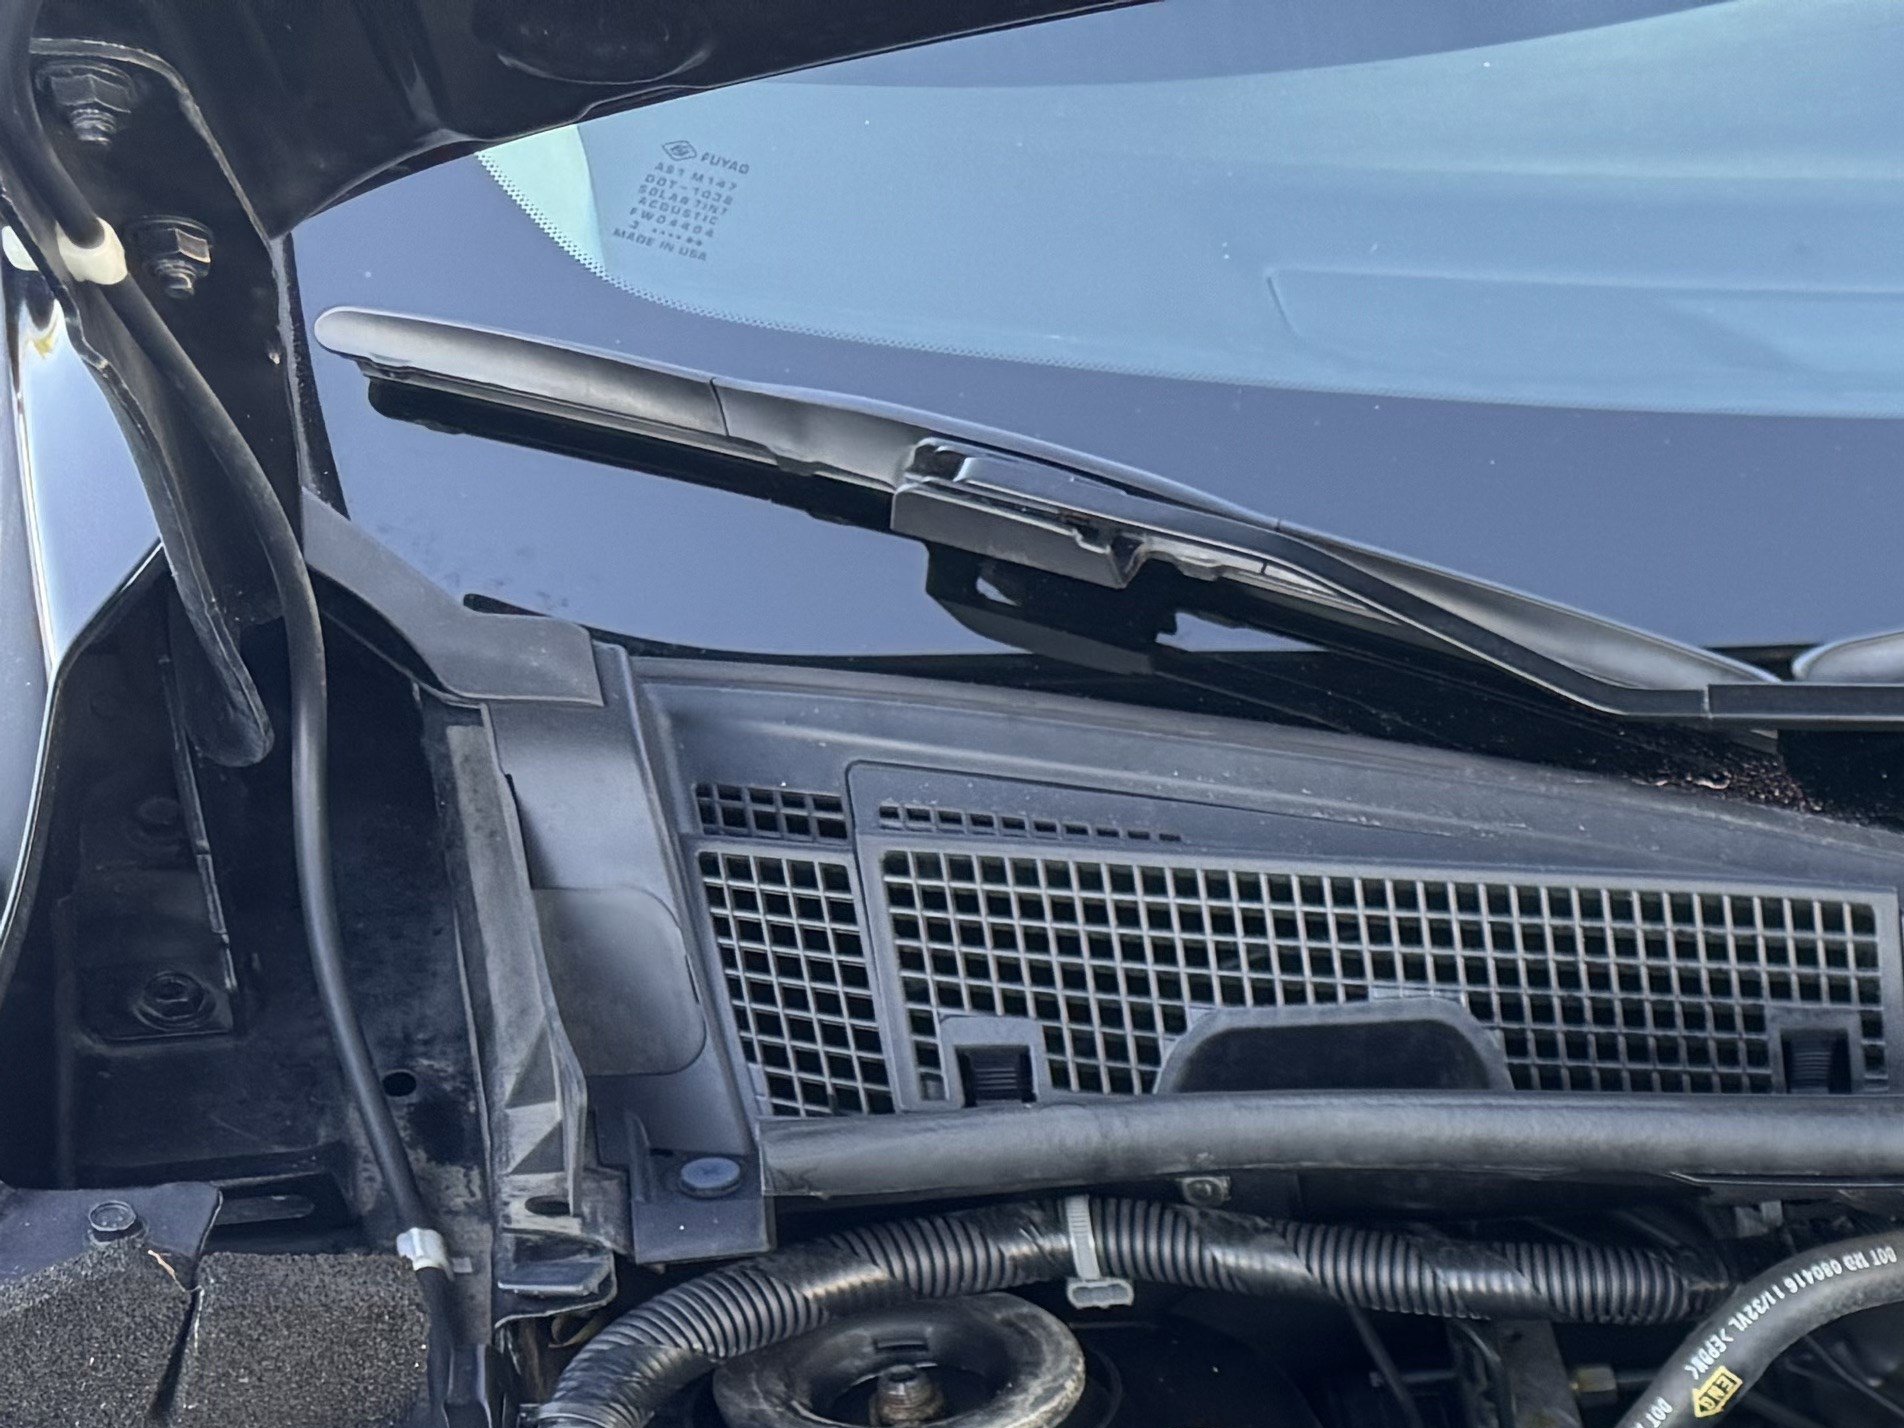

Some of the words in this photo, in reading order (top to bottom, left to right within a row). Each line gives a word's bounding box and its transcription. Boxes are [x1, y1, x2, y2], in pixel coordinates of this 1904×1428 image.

[701, 152, 750, 175] FUYAO
[638, 197, 719, 226] ACOUSTIC
[613, 227, 656, 248] MADE
[659, 239, 675, 252] IN
[678, 245, 707, 261] USA
